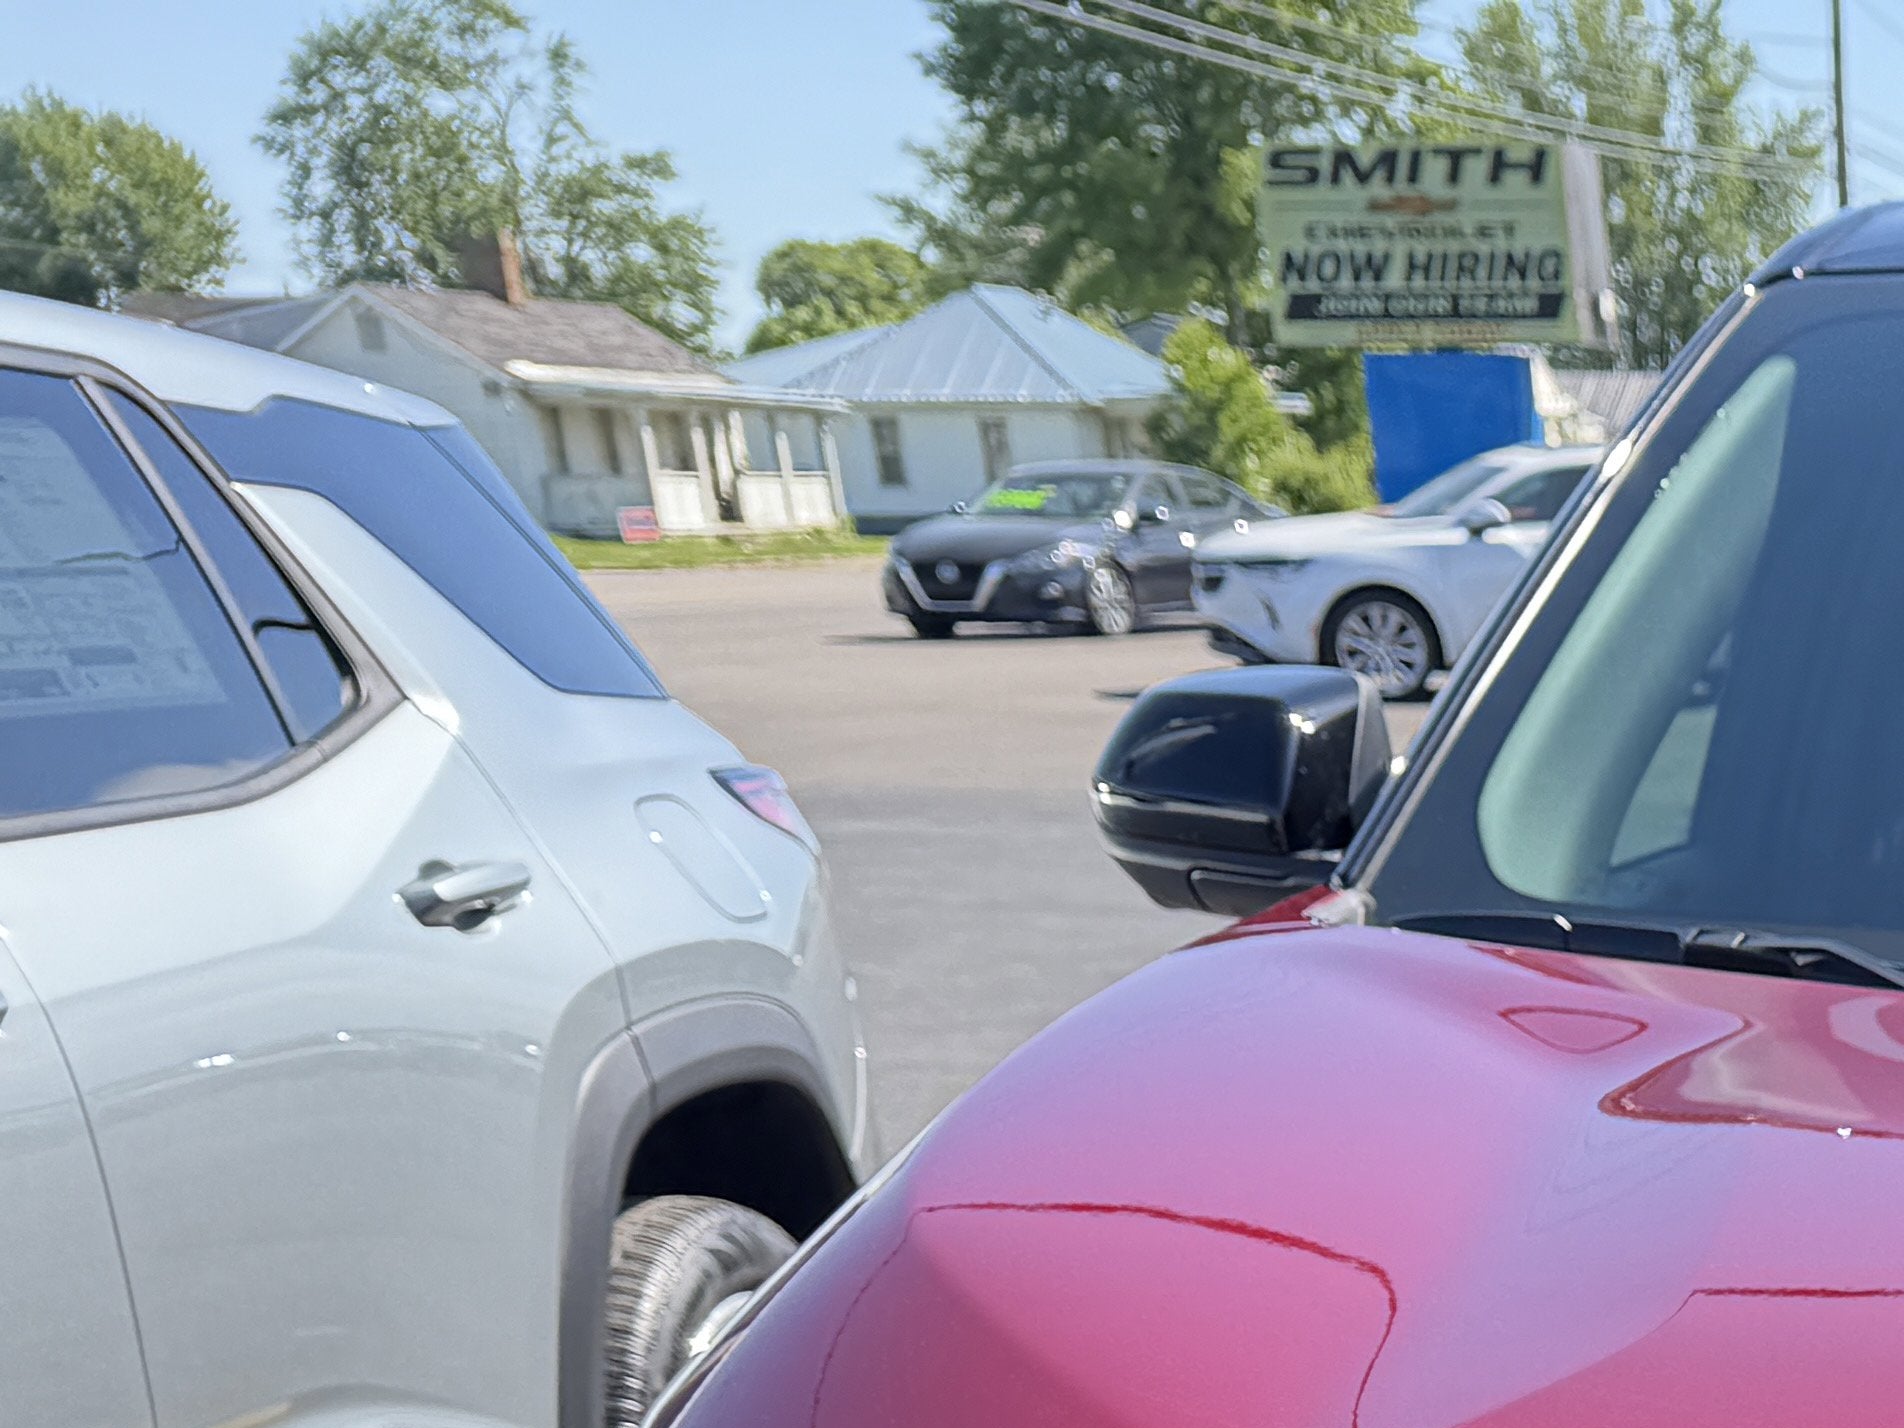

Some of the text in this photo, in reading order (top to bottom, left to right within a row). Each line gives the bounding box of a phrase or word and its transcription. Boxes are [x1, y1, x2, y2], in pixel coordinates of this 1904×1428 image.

[1266, 147, 1546, 186] SMITH
[1284, 250, 1561, 283] NOW HIRING
